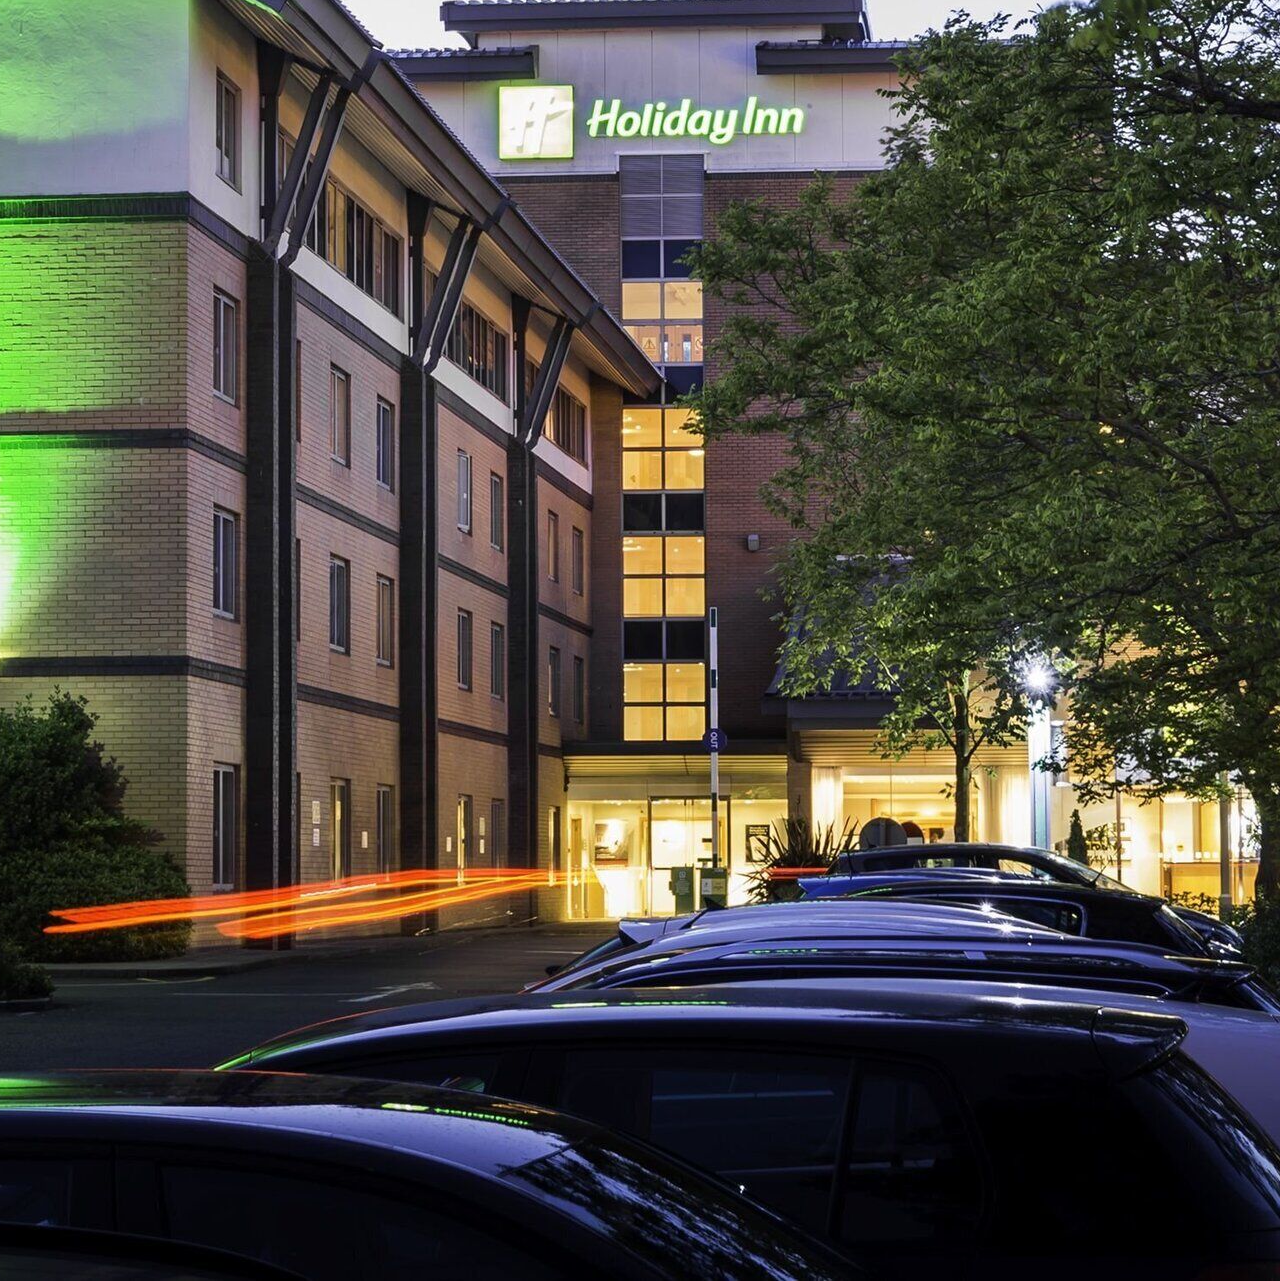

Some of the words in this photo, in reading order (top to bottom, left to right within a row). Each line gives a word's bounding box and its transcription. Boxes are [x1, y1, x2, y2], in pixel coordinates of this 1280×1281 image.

[586, 97, 739, 145] Holiday
[741, 96, 805, 135] Inn
[710, 731, 718, 749] OUT
